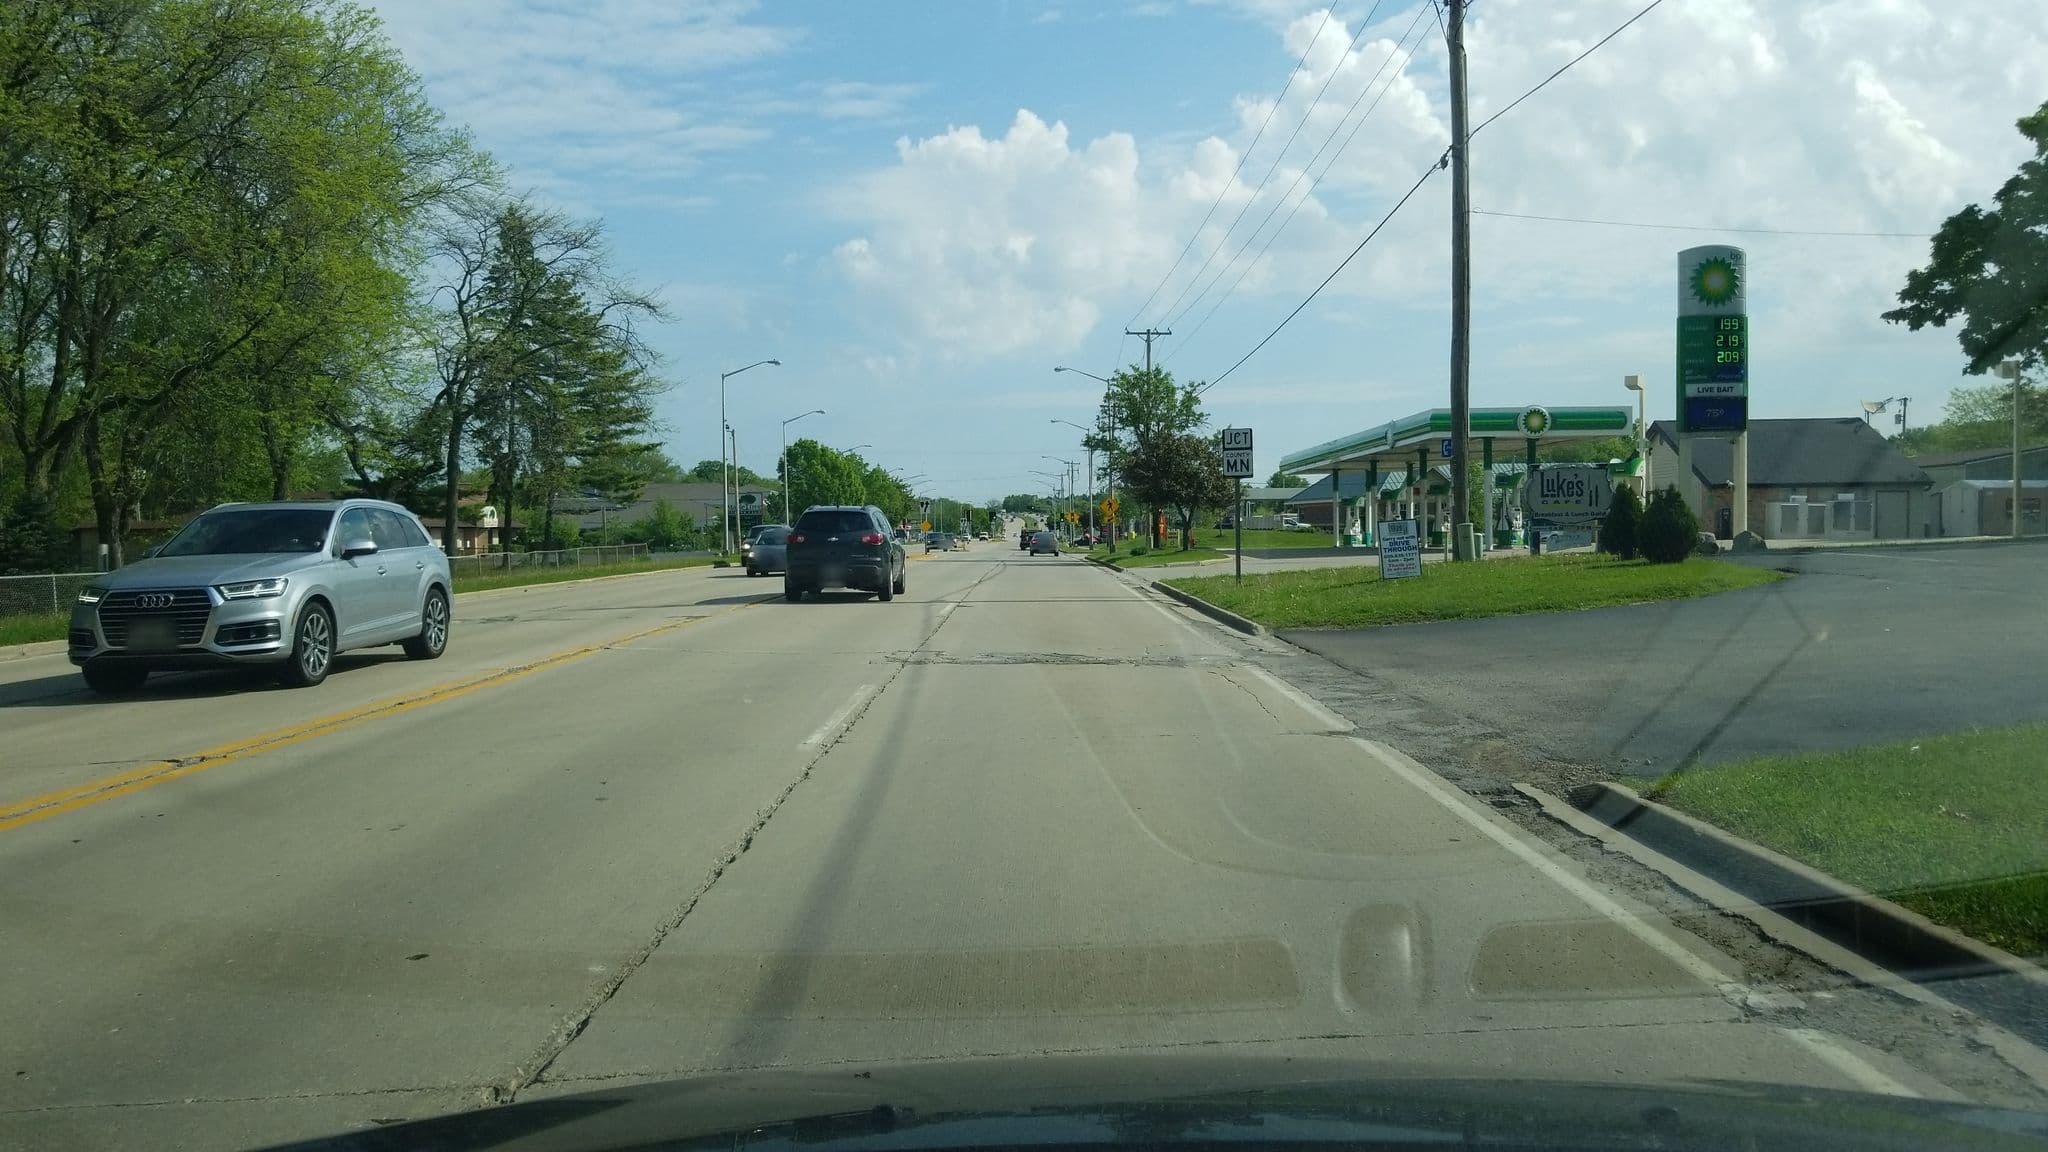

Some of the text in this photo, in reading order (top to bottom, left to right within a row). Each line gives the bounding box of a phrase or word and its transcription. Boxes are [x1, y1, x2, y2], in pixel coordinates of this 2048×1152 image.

[1697, 386, 1715, 394] LIVE
[1226, 431, 1249, 445] JCT
[1226, 458, 1250, 473] MN
[1541, 471, 1584, 498] Luke's
[1383, 544, 1418, 553] THROUGH
